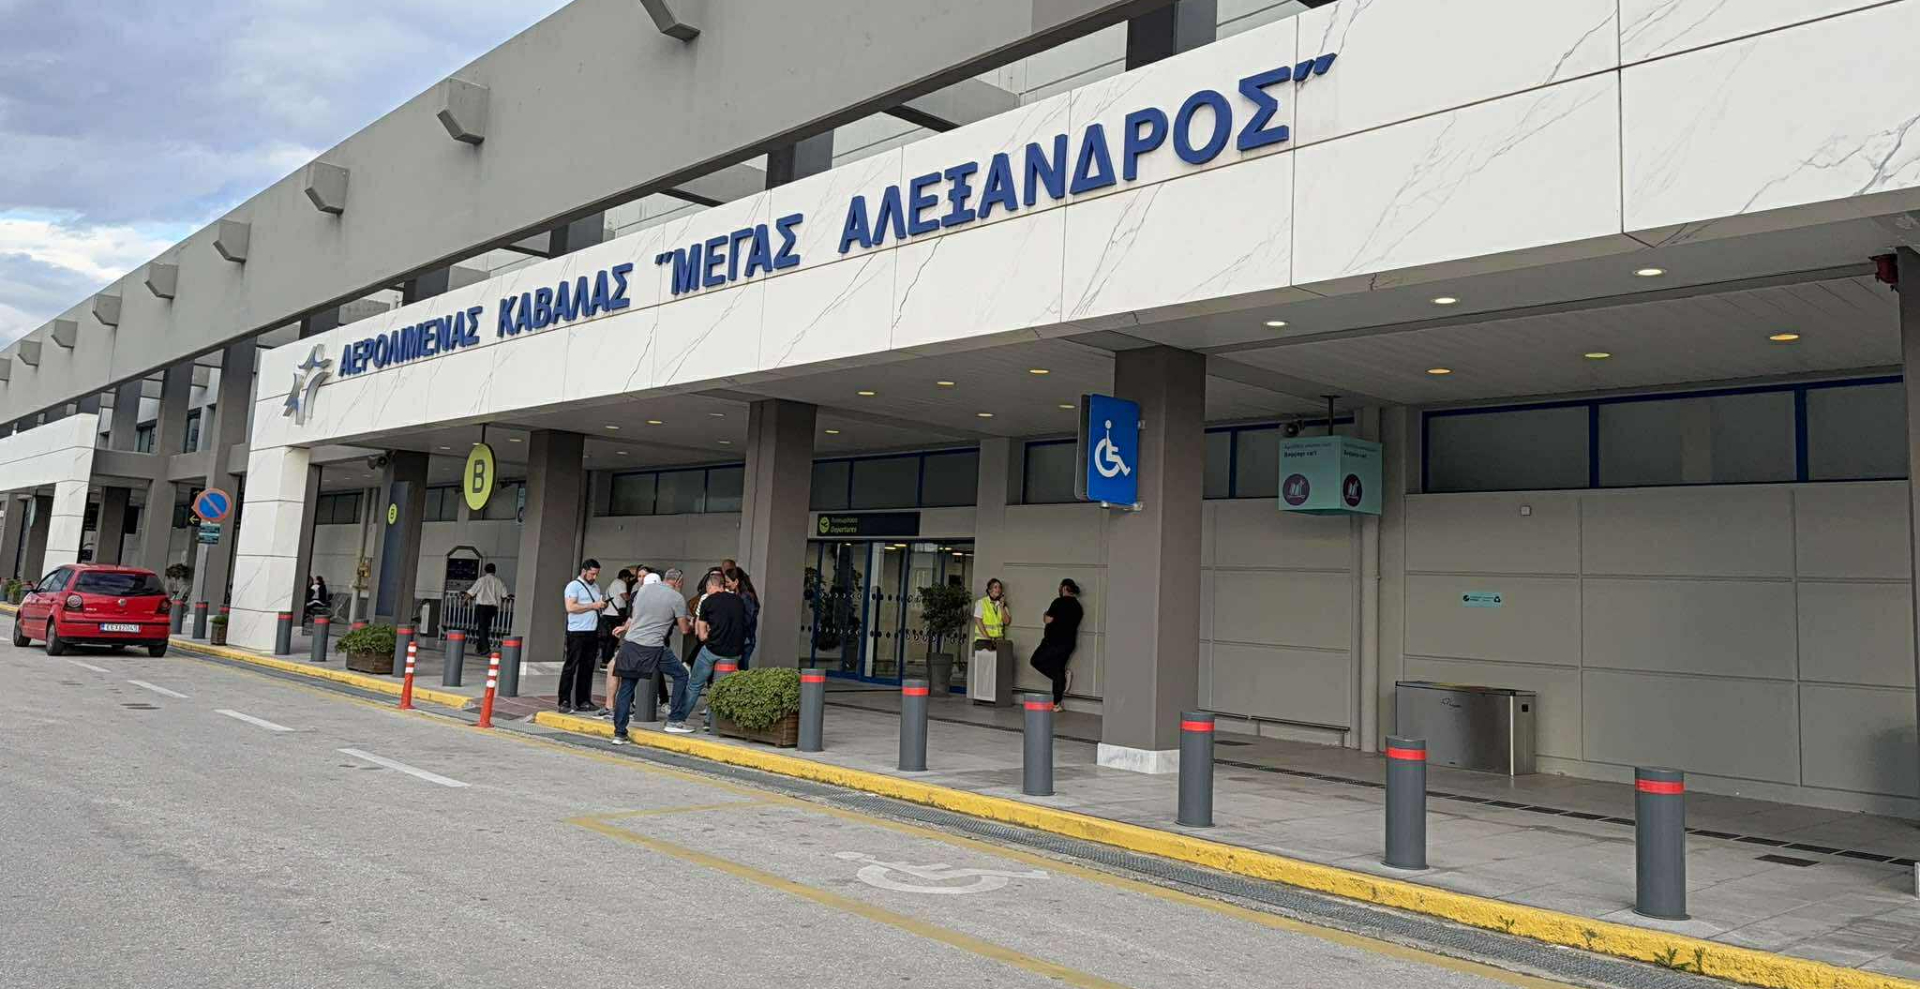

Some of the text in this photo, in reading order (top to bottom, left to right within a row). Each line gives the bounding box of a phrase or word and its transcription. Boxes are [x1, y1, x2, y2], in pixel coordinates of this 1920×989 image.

[338, 305, 483, 377] ΑΕΡΟΛΙΜΕΝΑΣ
[496, 262, 634, 338] ΚΑΒΑΛΑΣ
[472, 459, 485, 493] B
